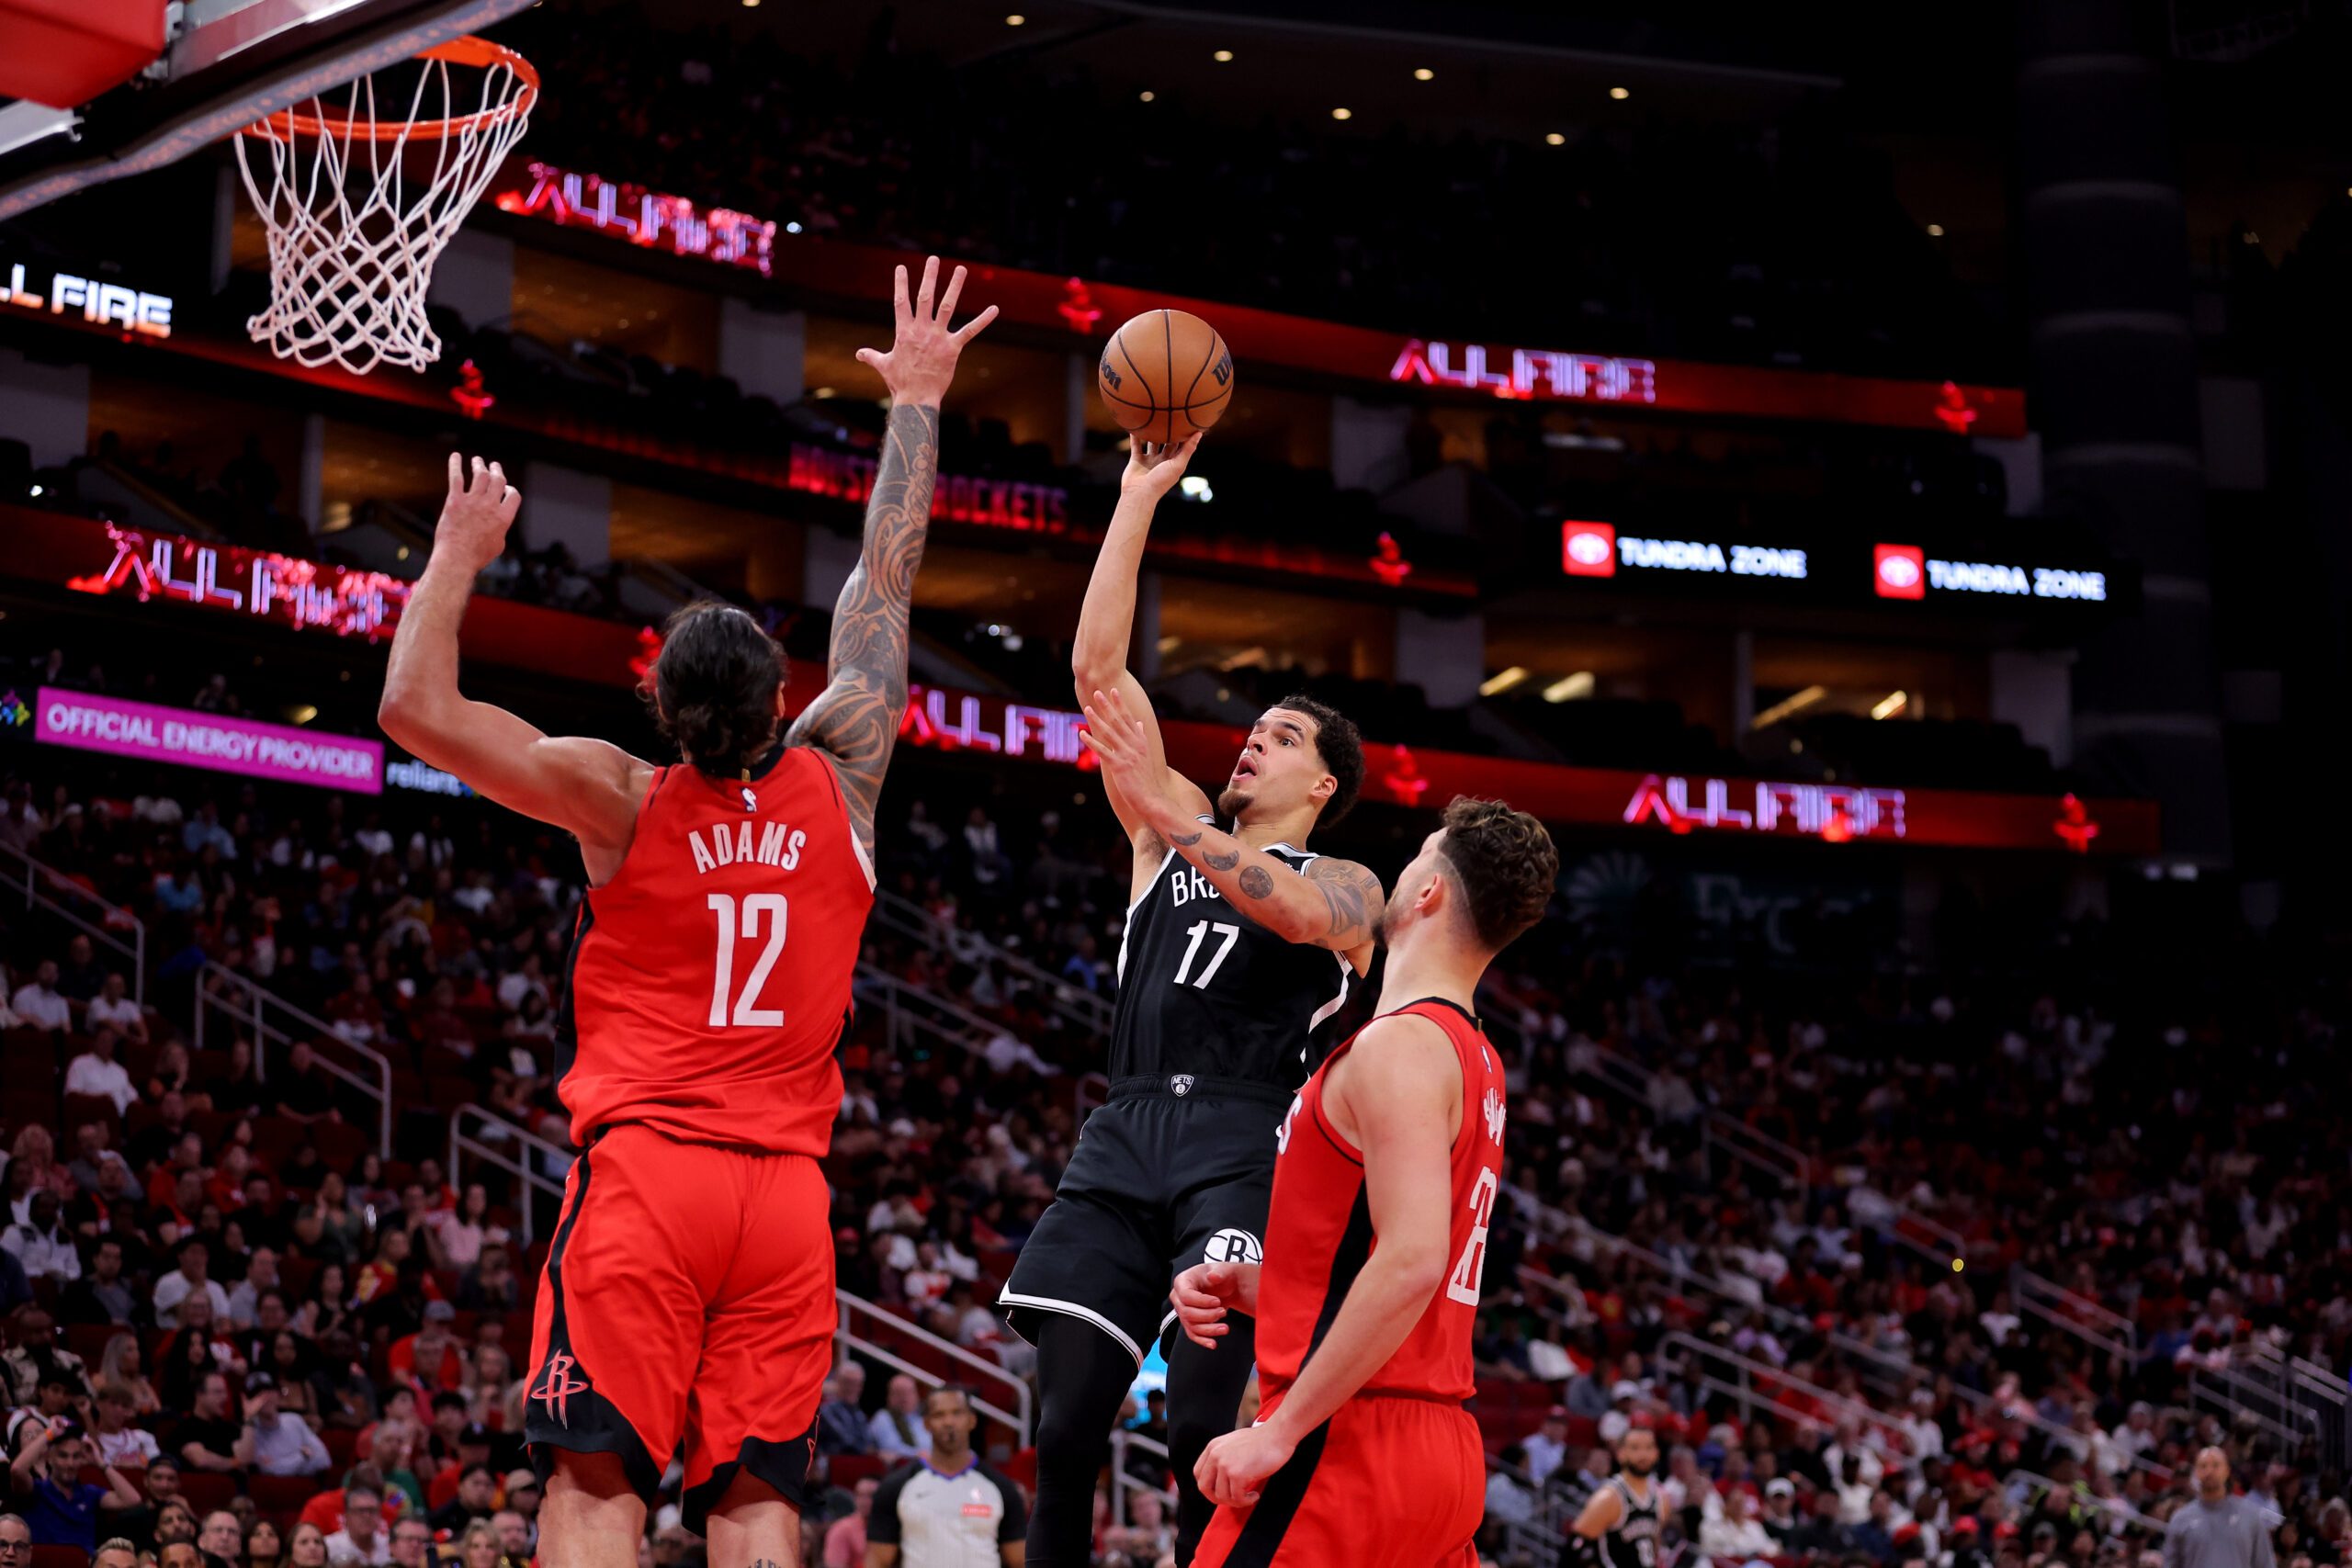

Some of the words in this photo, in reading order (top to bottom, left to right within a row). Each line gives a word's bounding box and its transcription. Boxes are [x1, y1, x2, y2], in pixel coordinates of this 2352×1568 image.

[51, 273, 173, 339] FIRE
[1616, 536, 1727, 572] TUNDRA
[1729, 545, 1807, 579] ZONE
[1926, 559, 2030, 595] TUNDRA
[2033, 568, 2107, 602] ZONE
[46, 703, 159, 747] OFFICIAL
[163, 720, 258, 761] ENERGY
[258, 736, 374, 780] PROVIDER
[688, 820, 807, 874] ADAMS
[707, 893, 788, 1027] 12
[1173, 919, 1240, 990] 17
[1172, 1076, 1192, 1085] NETS
